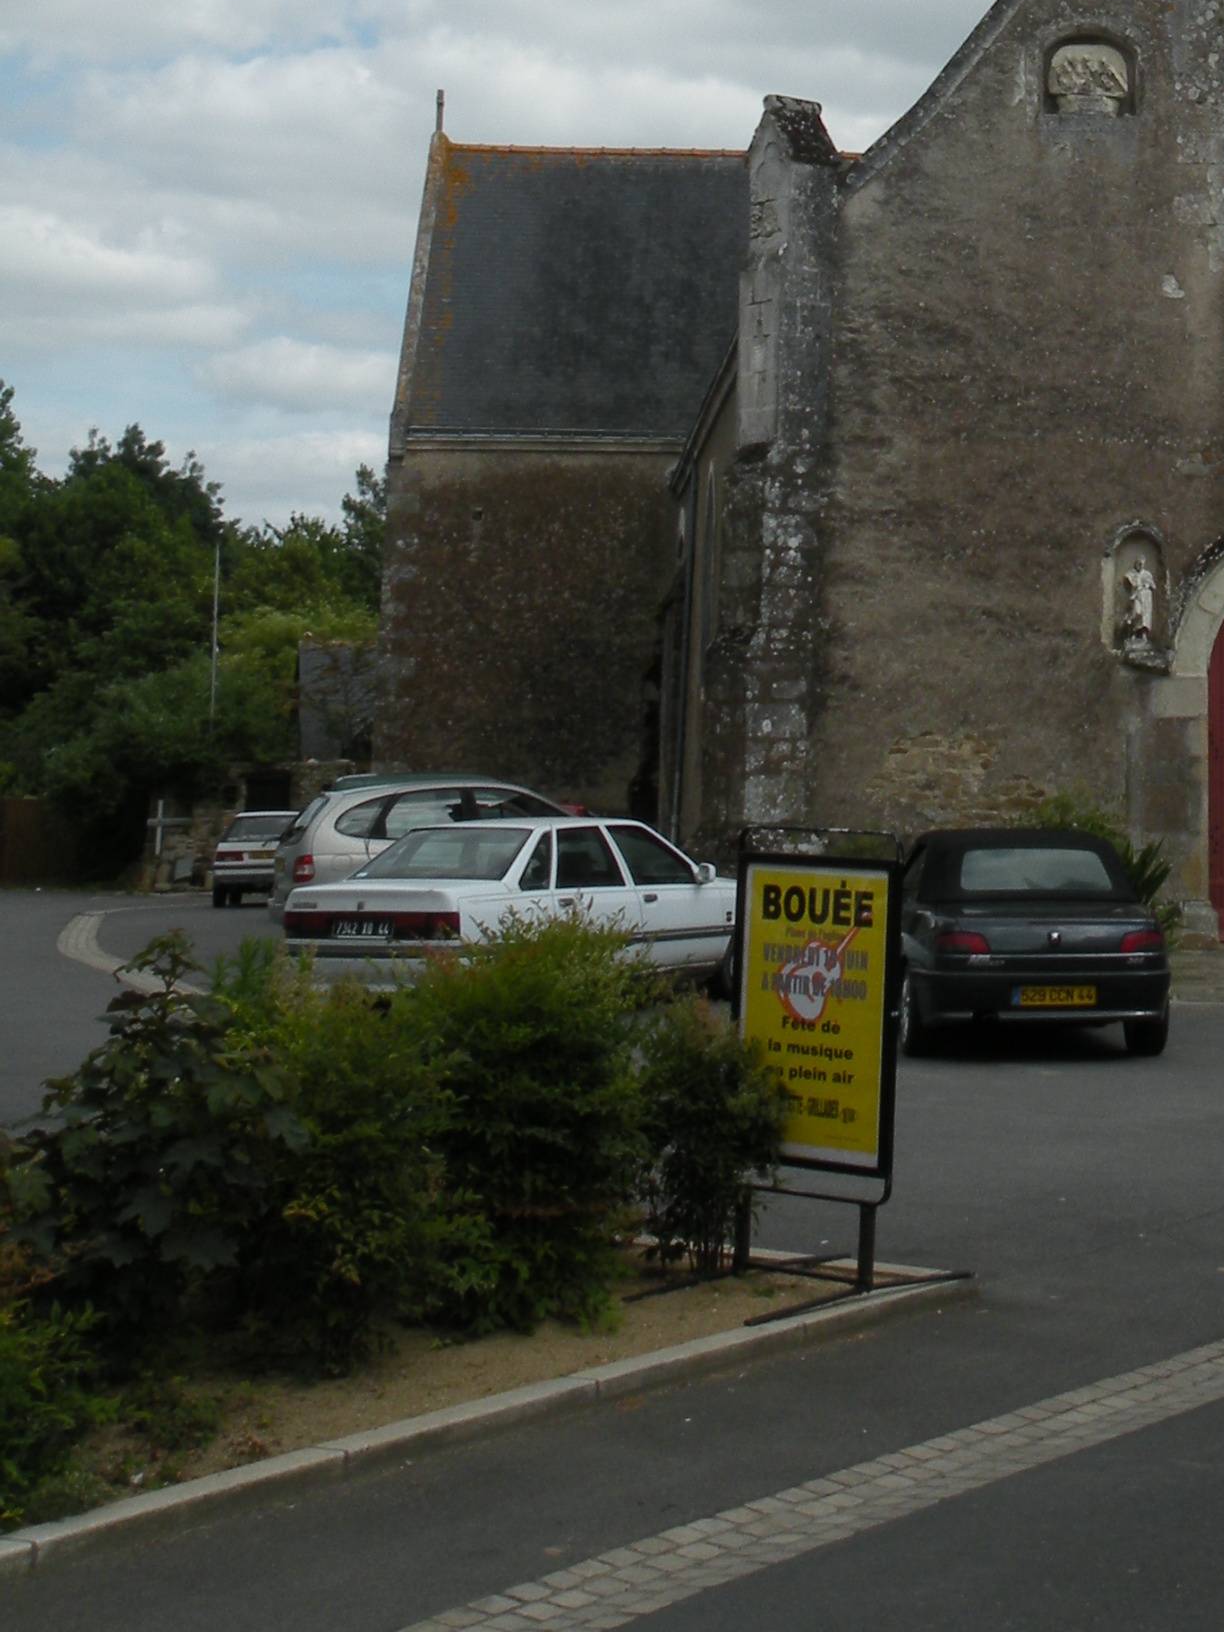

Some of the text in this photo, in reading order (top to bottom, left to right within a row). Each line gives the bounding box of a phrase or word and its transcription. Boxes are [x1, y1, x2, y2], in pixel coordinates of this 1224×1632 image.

[761, 879, 874, 928] BOUÉE
[821, 1020, 841, 1035] de
[768, 1037, 854, 1061] la musique
[788, 1065, 827, 1081] plein
[832, 1070, 855, 1084] air
